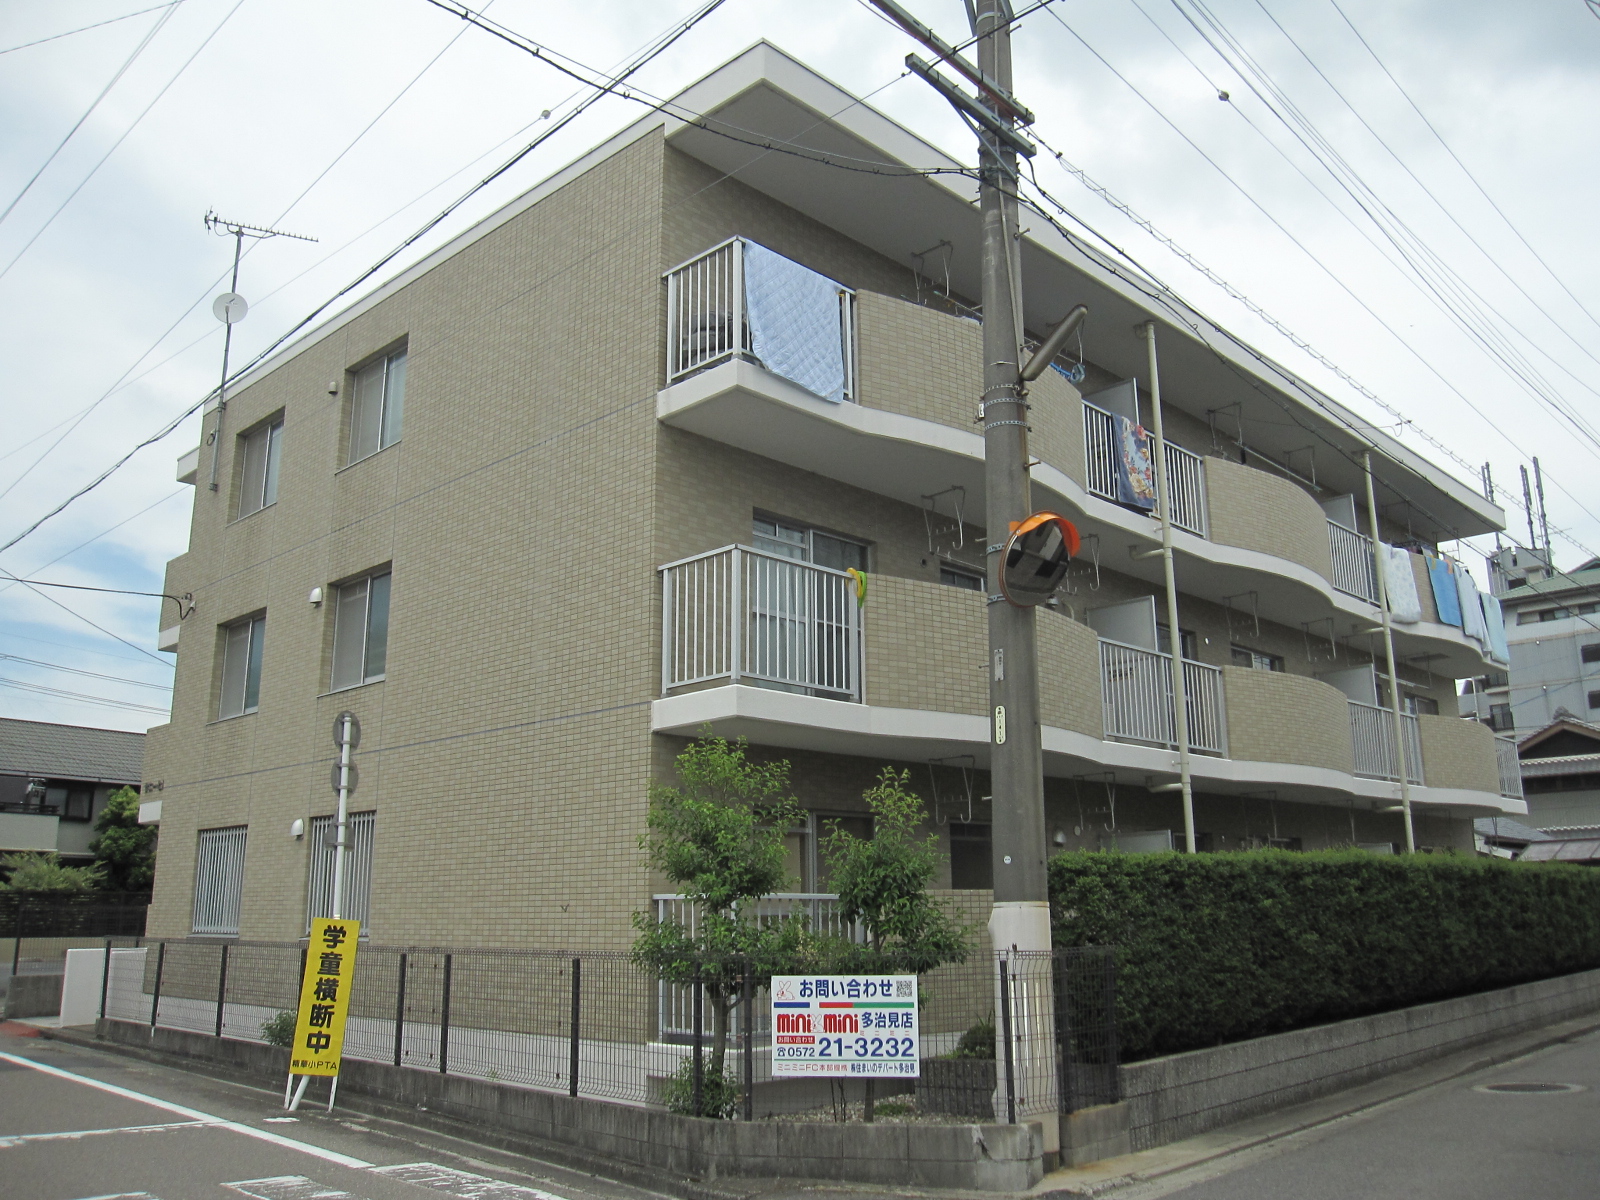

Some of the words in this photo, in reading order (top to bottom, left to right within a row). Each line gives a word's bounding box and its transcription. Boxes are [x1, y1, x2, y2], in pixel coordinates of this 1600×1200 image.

[306, 924, 347, 1055] 学童横断中
[799, 979, 893, 998] お問い合わせ
[776, 1013, 811, 1033] mini
[823, 1013, 859, 1033] mini
[861, 1012, 913, 1029] 多治見店
[787, 1047, 815, 1057] 0572
[818, 1037, 914, 1057] 21-3232
